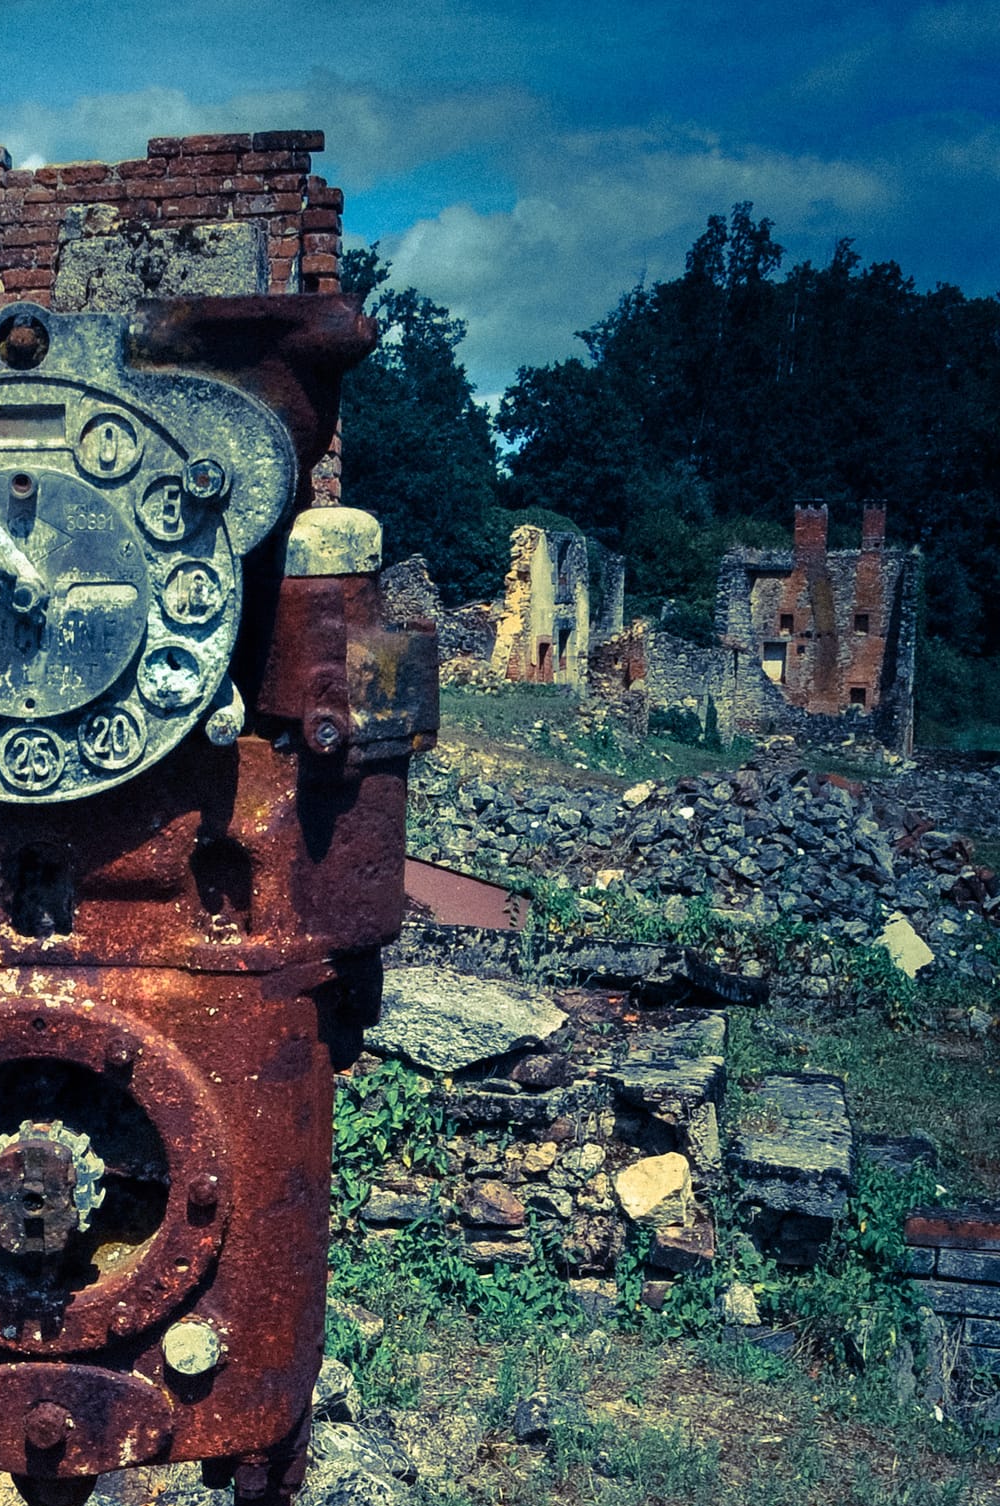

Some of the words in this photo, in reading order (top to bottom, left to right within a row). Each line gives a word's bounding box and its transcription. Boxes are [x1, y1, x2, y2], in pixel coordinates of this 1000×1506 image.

[99, 422, 118, 468] 0
[93, 714, 130, 756] 20
[13, 737, 49, 779] 25
